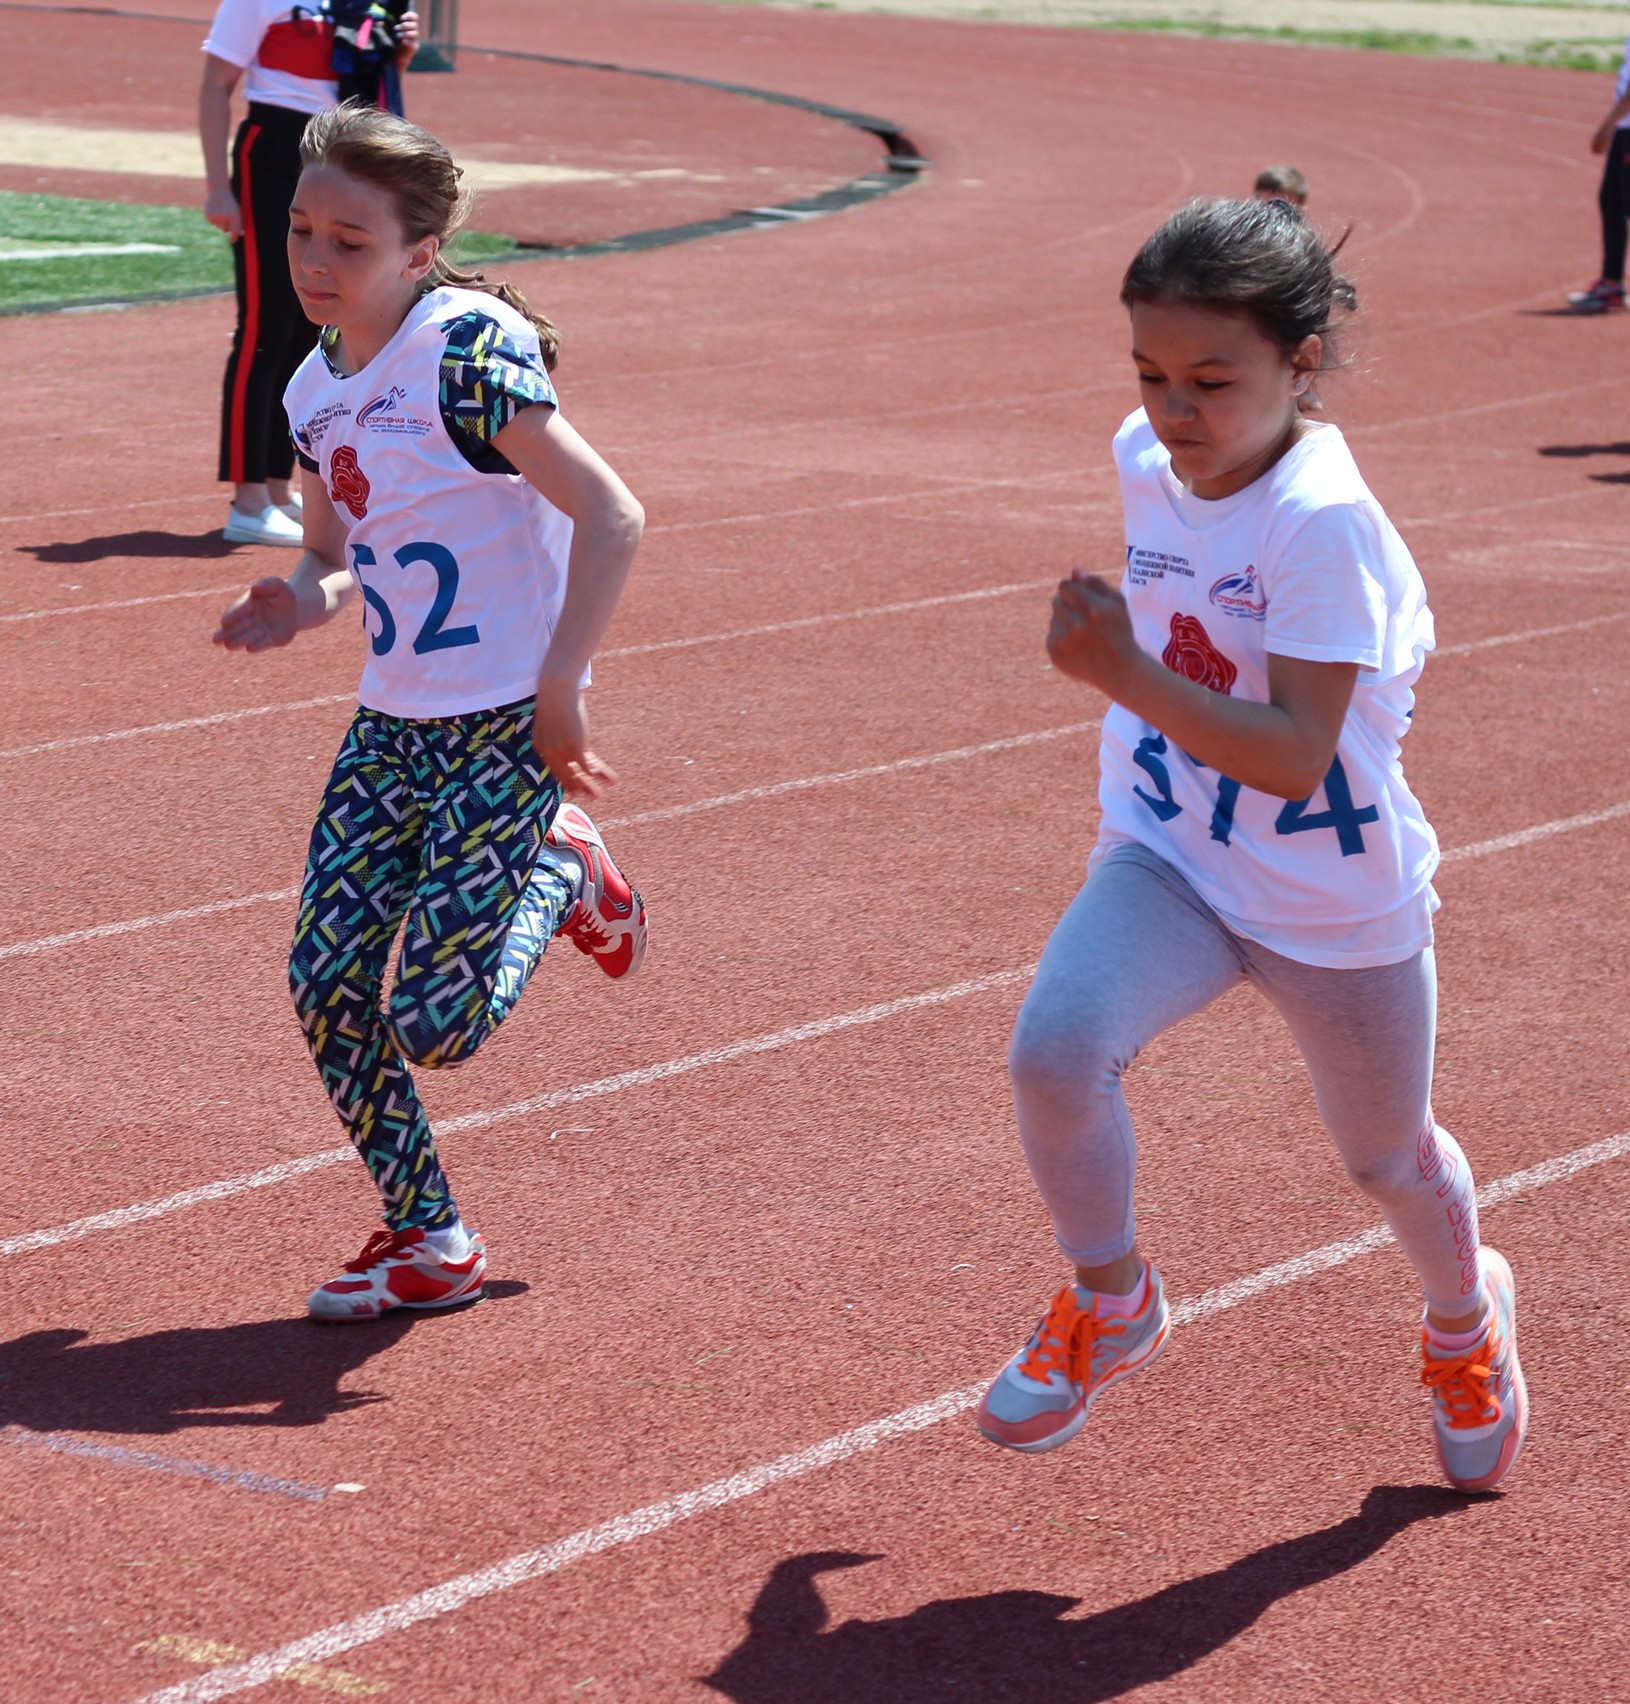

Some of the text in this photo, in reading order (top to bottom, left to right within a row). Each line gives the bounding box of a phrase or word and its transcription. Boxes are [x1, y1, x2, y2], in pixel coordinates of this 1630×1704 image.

[366, 416, 433, 428] СПОРТИВНАЯ ШКОЛА
[350, 541, 480, 656] 52
